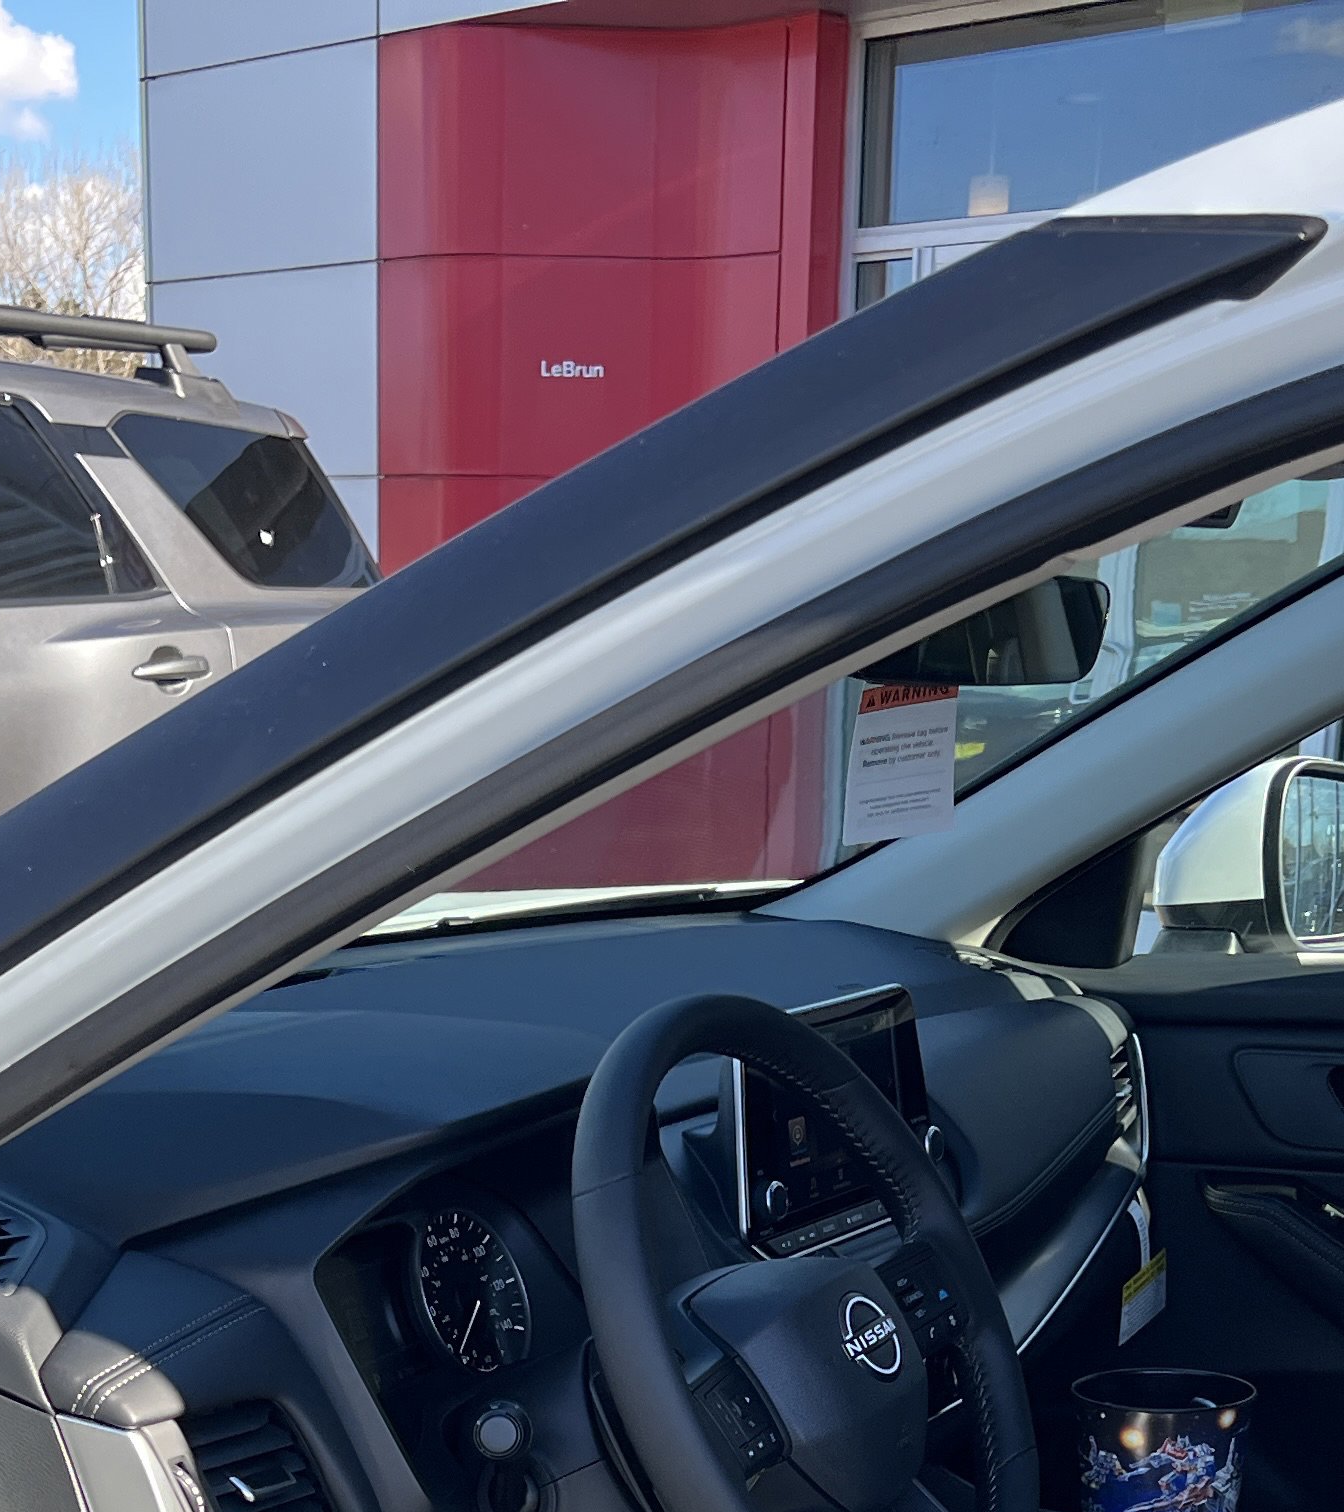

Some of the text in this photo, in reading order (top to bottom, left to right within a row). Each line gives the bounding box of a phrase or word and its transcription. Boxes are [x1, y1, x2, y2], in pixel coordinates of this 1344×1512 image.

[540, 360, 604, 378] LeBrun
[880, 685, 950, 706] WARNING
[449, 1227, 460, 1239] 80
[426, 1235, 438, 1248] 60
[472, 1244, 486, 1257] 100
[844, 1316, 897, 1357] NISSAN
